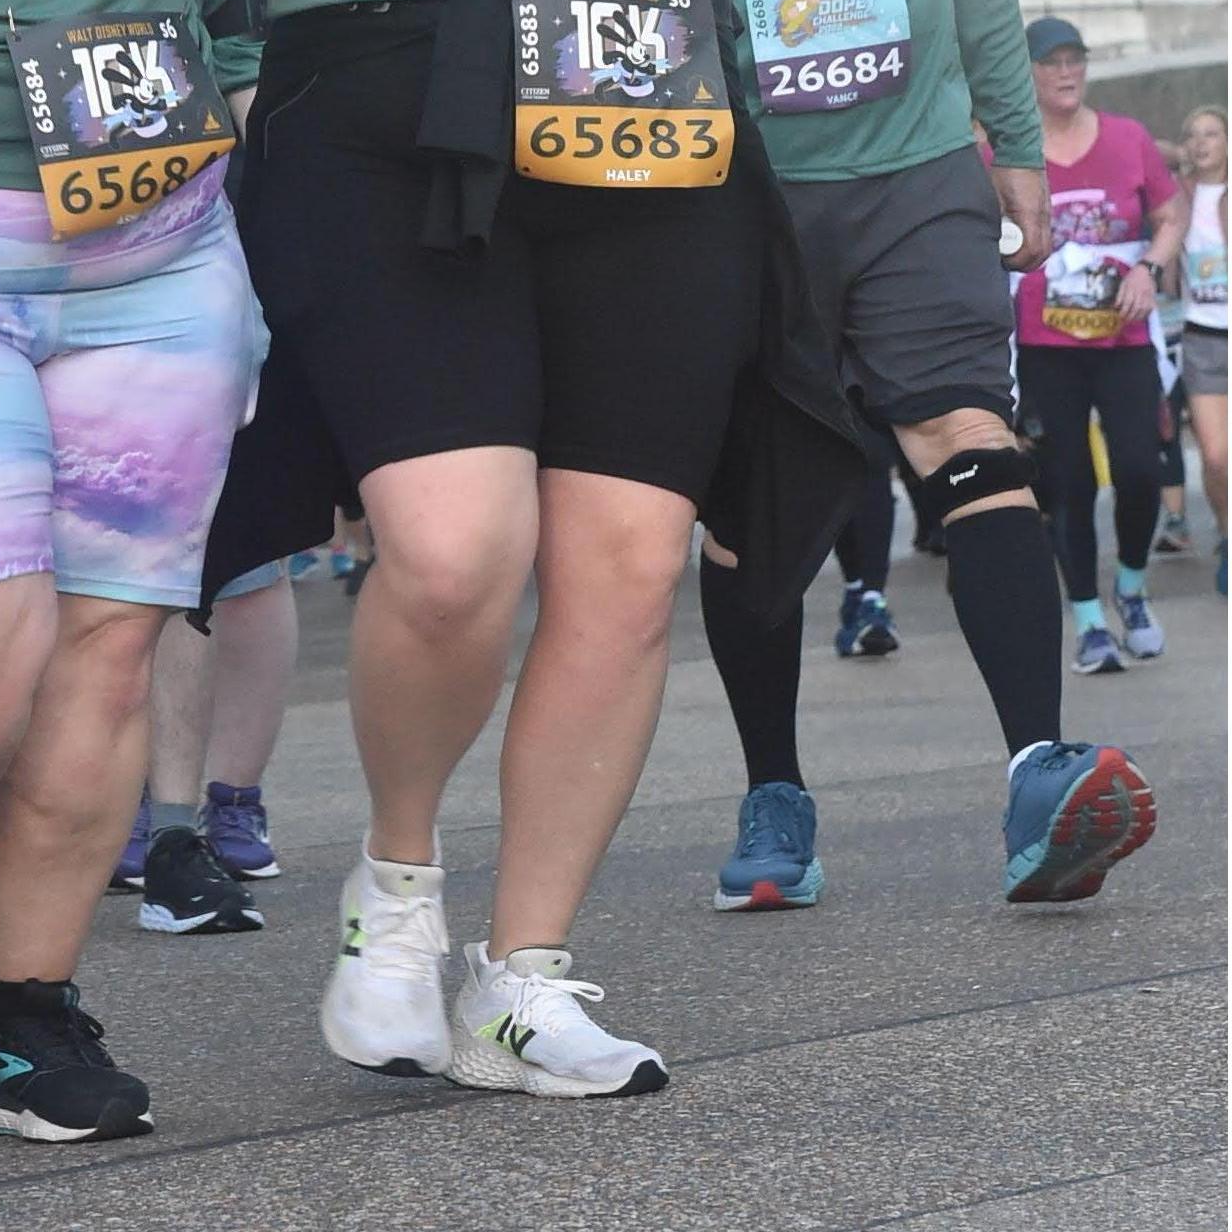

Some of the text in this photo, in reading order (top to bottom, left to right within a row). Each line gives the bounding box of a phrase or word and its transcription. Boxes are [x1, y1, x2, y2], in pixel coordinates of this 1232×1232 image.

[66, 21, 155, 44] WALT DISNEY WORLD
[519, 3, 539, 76] 65683
[570, 0, 667, 74] 10K
[21, 58, 55, 134] 65684
[72, 39, 178, 118] 10K
[769, 46, 904, 97] 26684
[529, 116, 720, 160] 65683
[606, 169, 652, 182] HALEY
